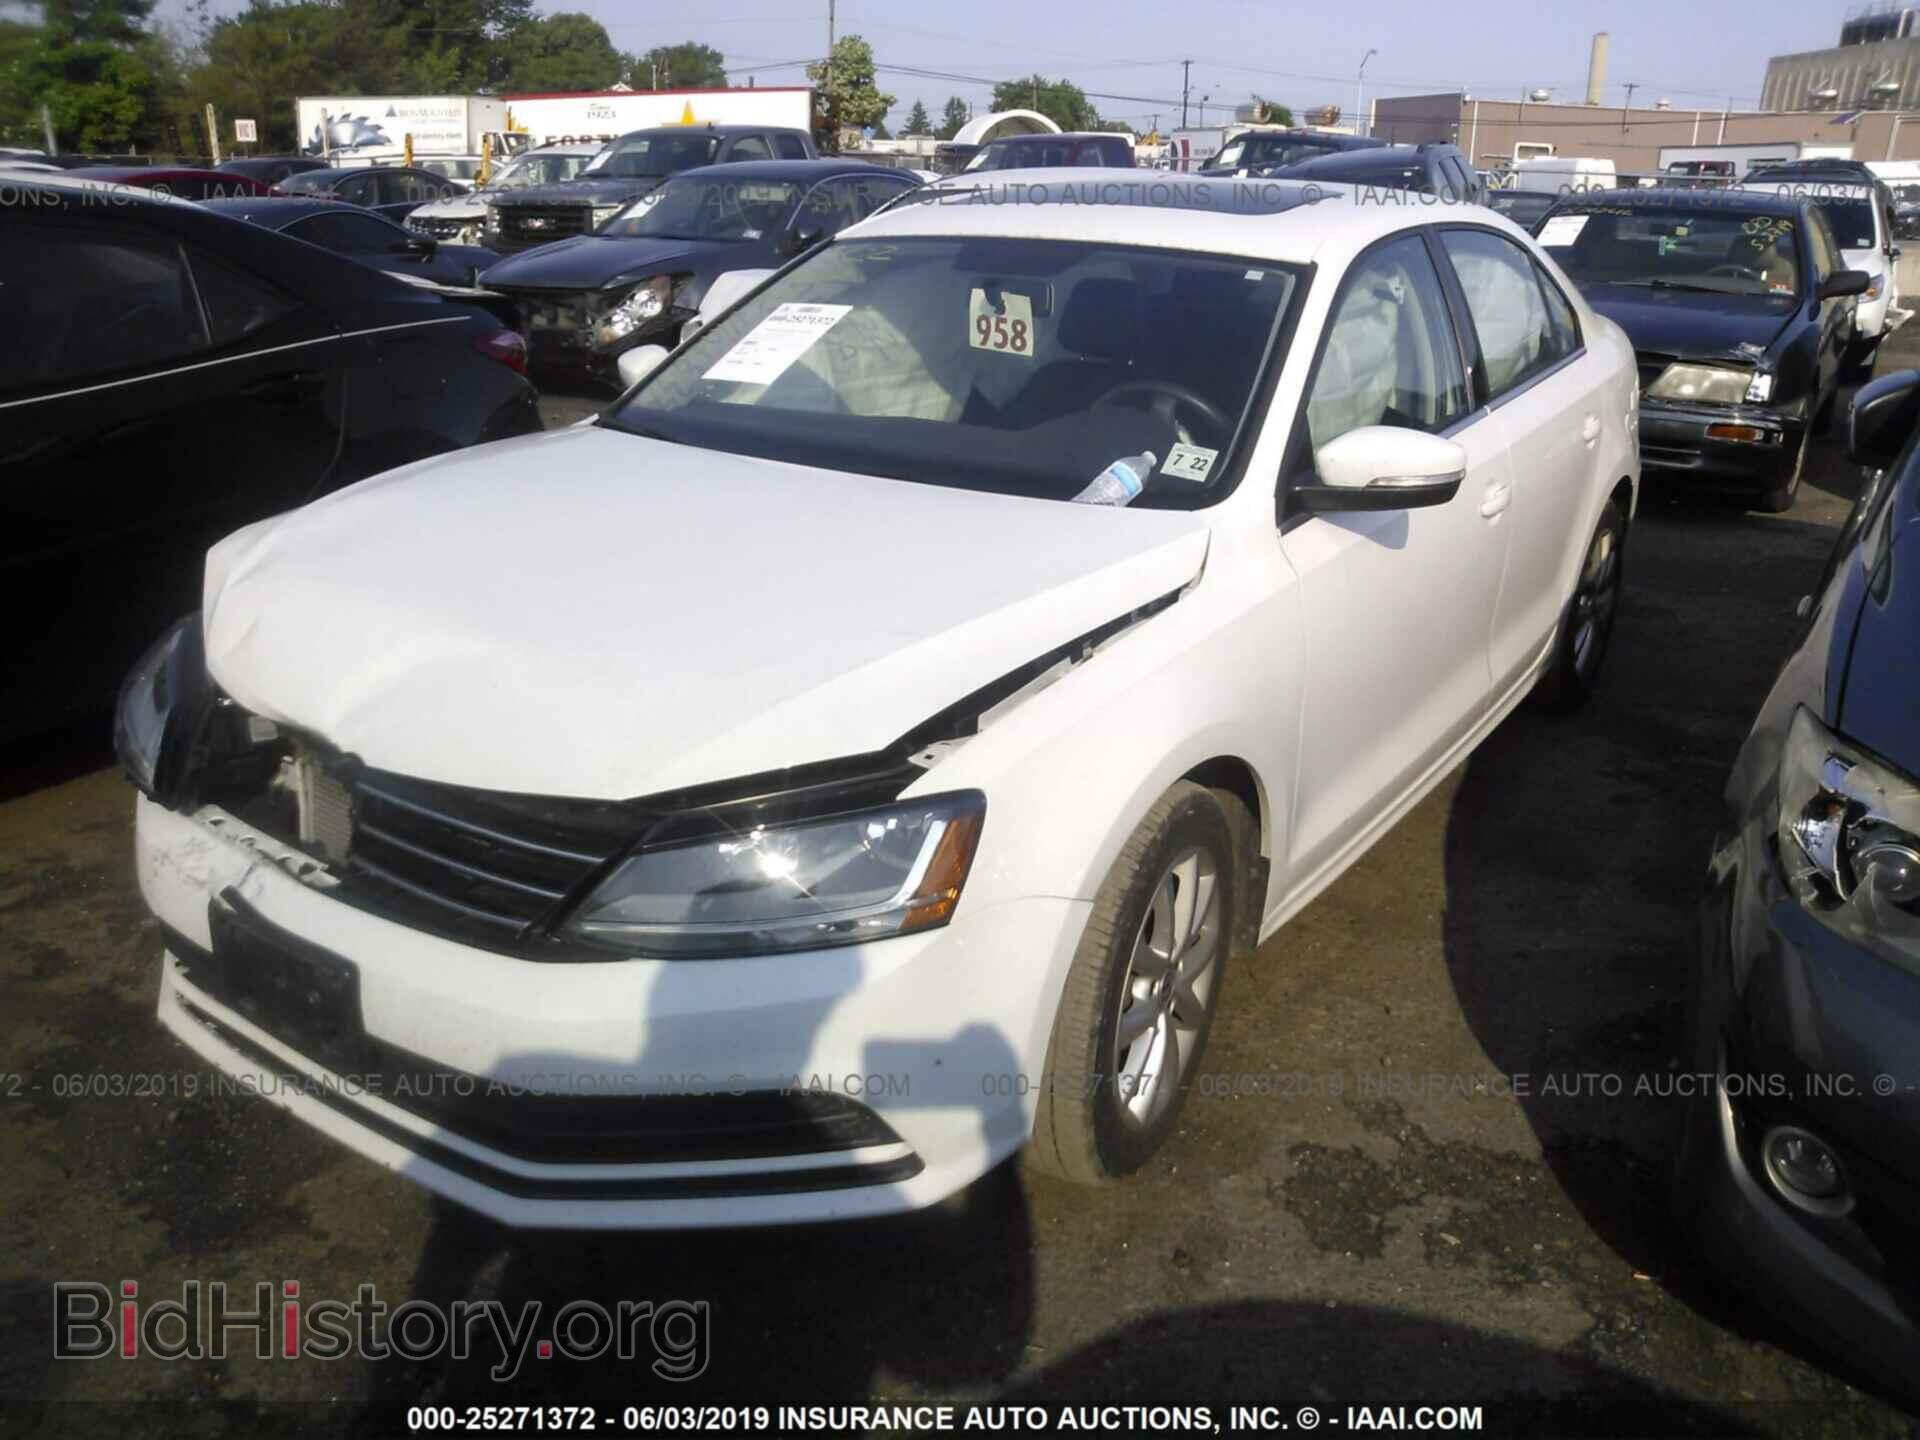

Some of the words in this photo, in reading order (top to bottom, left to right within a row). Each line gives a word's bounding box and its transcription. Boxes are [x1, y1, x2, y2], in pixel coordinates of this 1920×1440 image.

[976, 313, 1027, 352] 958
[1172, 454, 1184, 466] 7
[1190, 457, 1208, 471] 22
